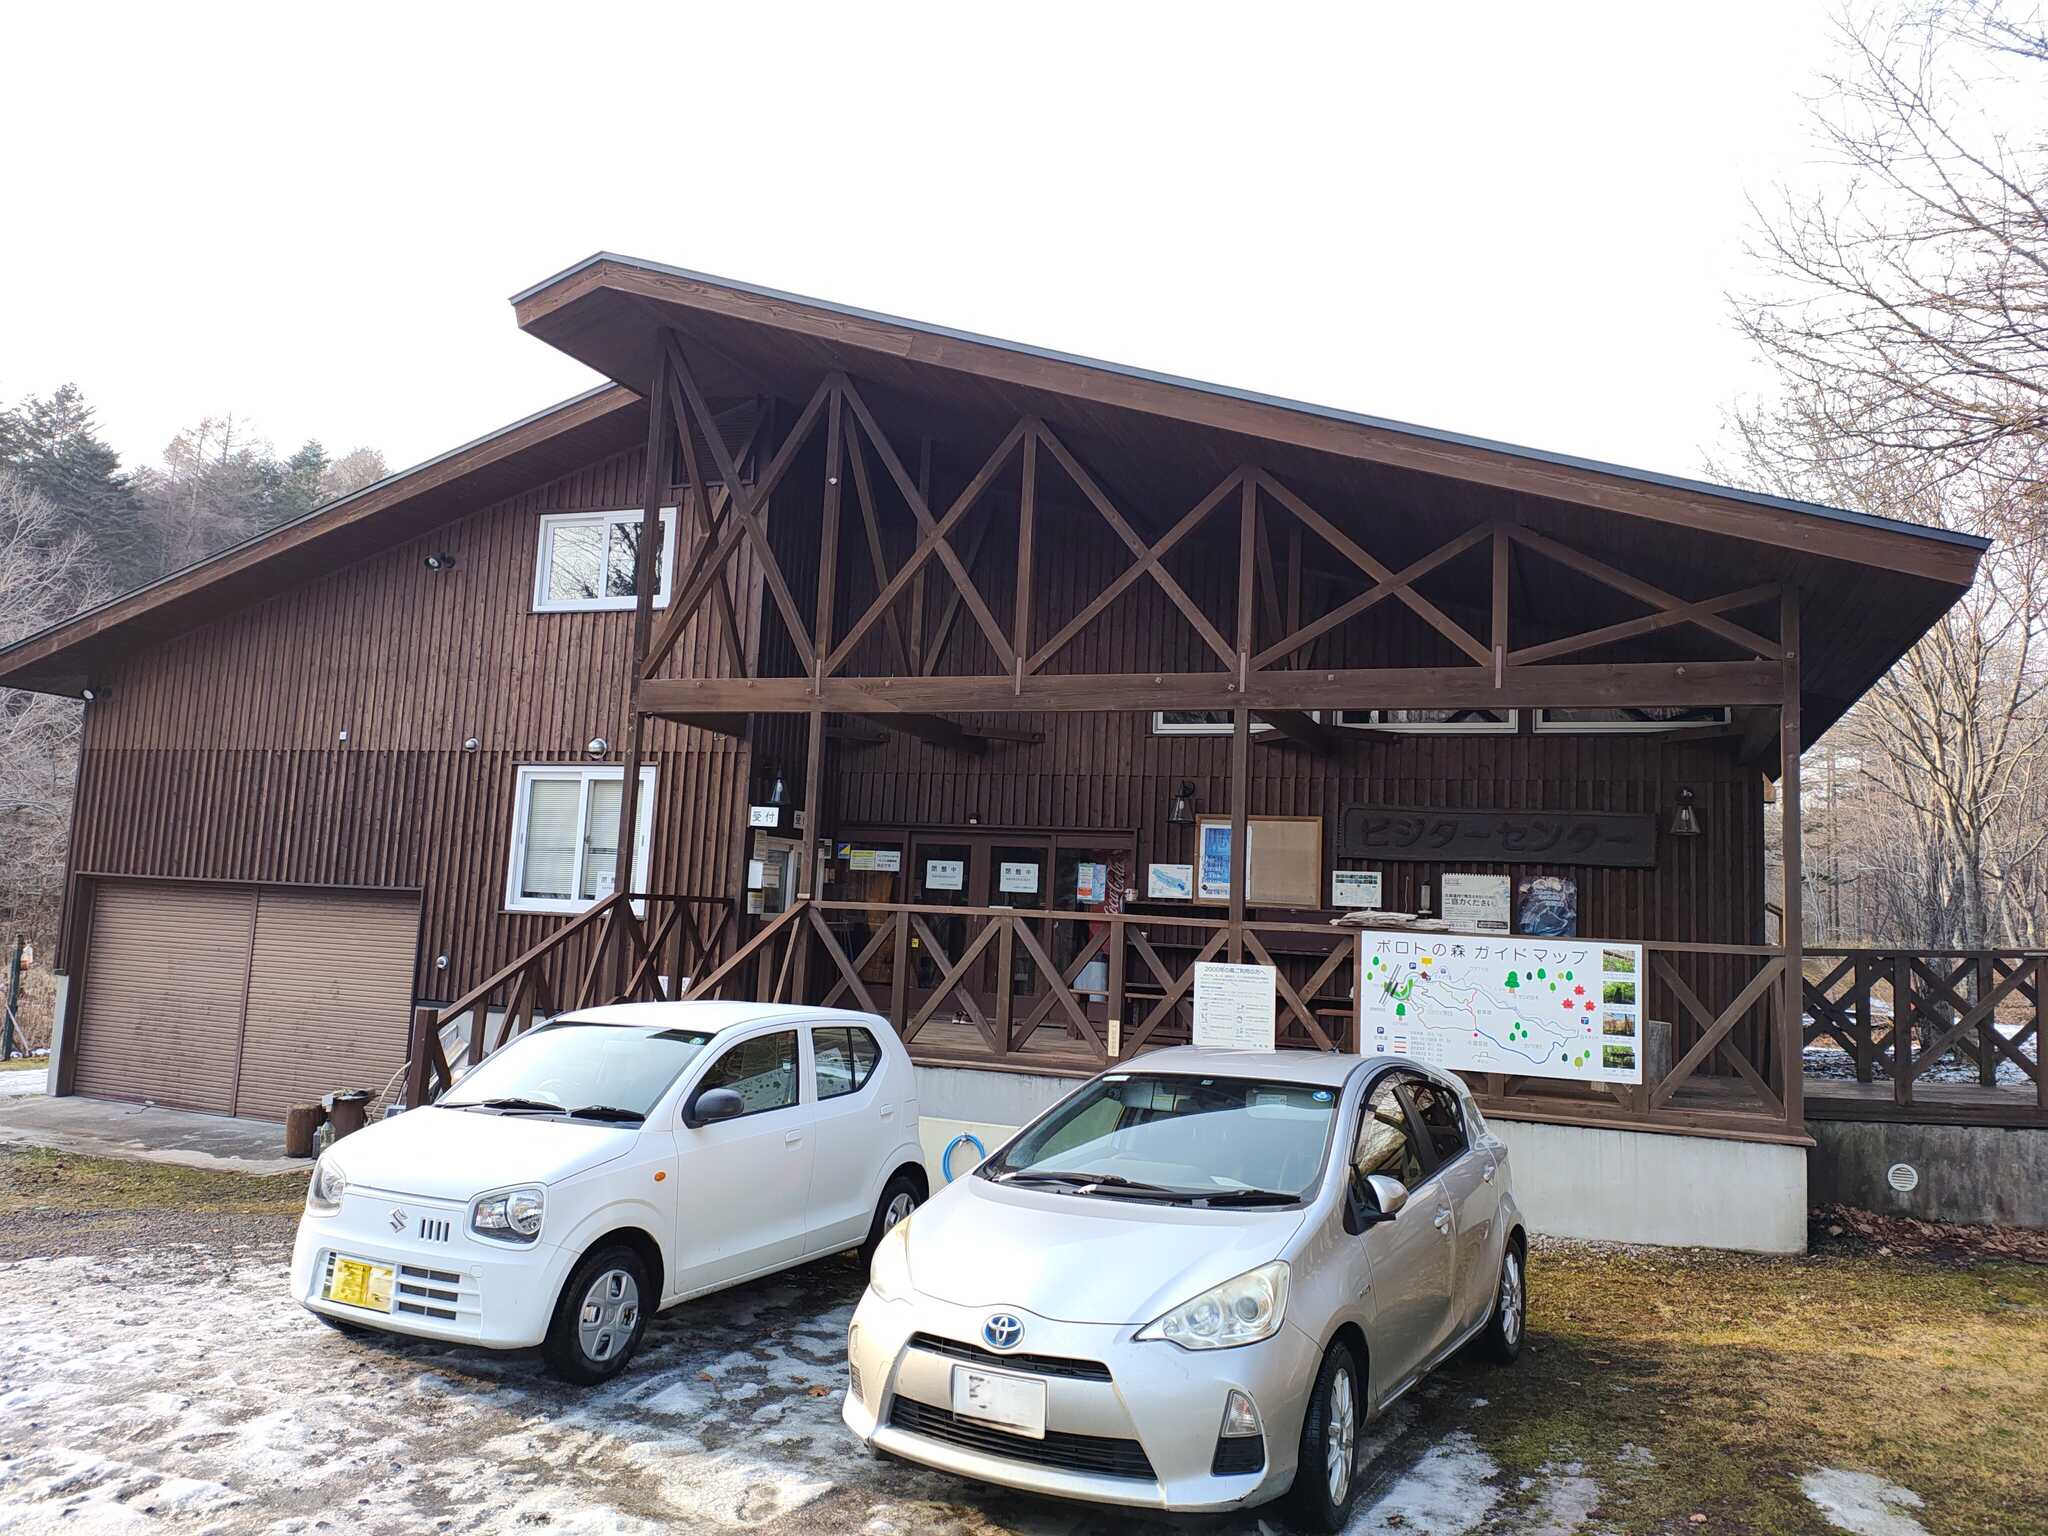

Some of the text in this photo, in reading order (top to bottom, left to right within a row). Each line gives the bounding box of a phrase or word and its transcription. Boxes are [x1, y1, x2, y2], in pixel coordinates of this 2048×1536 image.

[752, 810, 775, 823] 受付
[1361, 817, 1633, 853] ビジターセンター
[1377, 940, 1588, 965] ポロトの森 ガイドマップ
